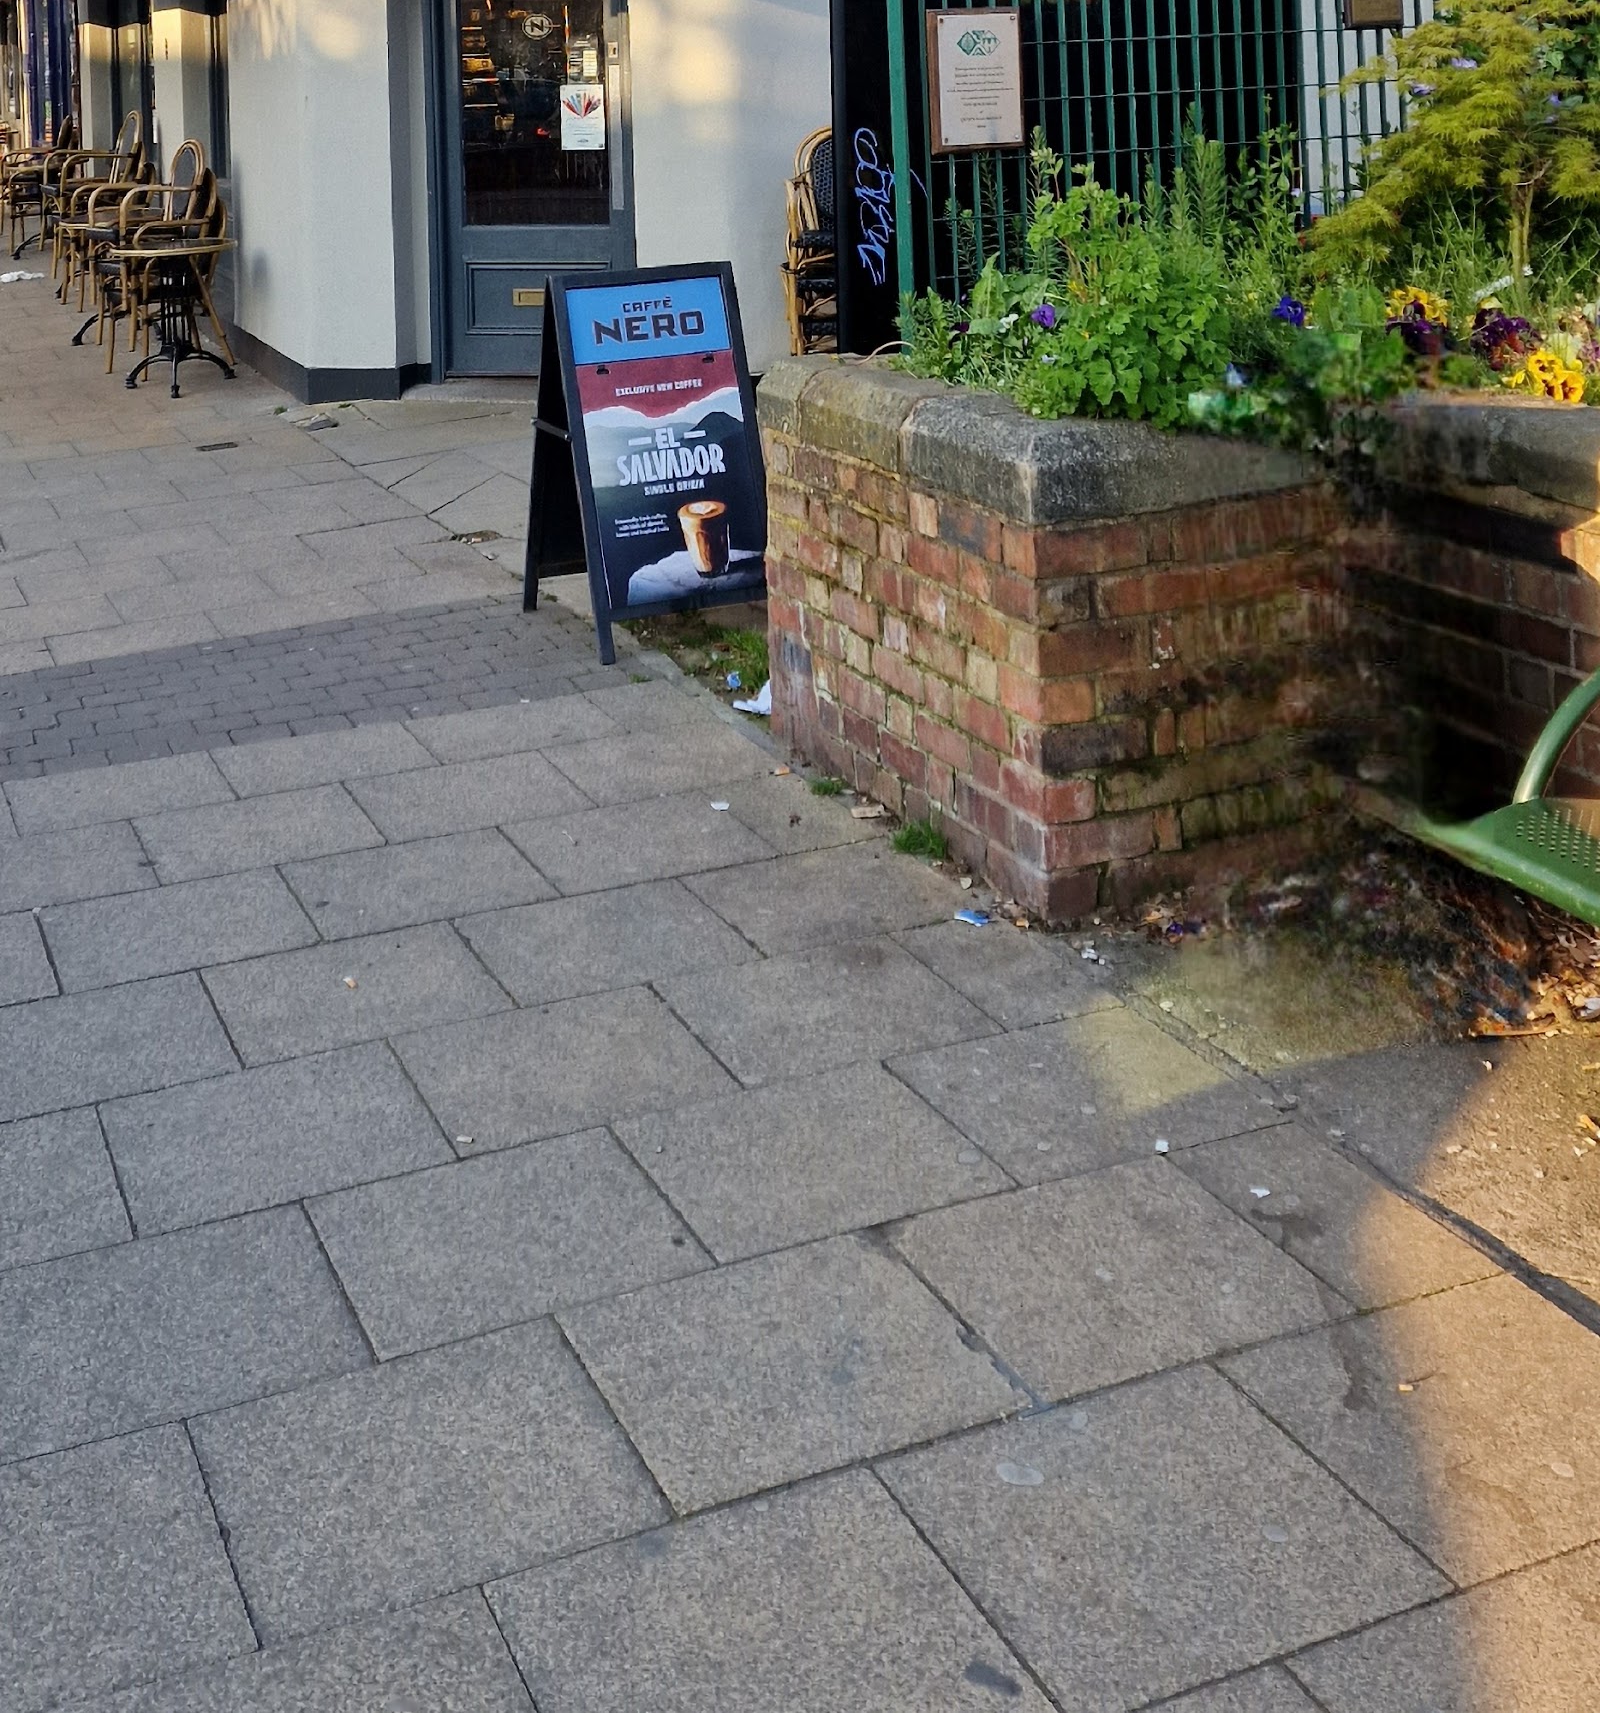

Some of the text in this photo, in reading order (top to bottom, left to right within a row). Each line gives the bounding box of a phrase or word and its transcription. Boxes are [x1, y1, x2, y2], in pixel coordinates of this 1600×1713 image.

[593, 309, 706, 345] NERO
[674, 378, 703, 390] COFFEE
[654, 426, 681, 450] EL
[616, 443, 726, 487] SALVADOR
